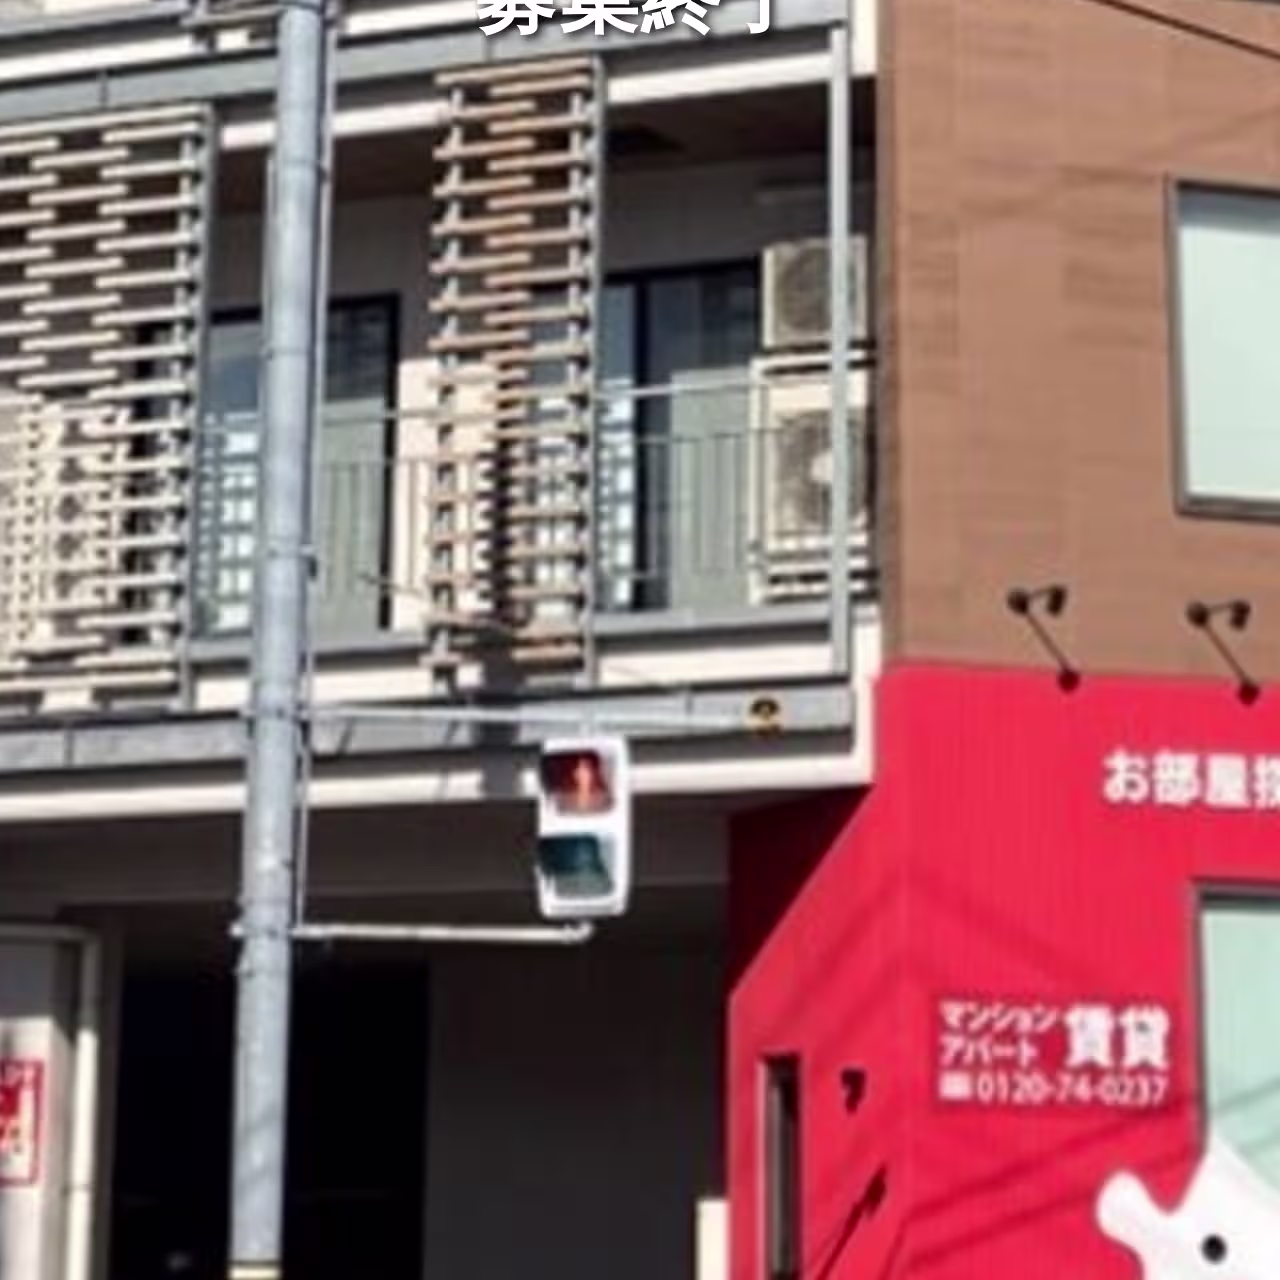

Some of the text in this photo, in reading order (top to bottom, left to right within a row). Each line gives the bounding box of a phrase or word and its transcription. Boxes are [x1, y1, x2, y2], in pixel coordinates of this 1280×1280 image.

[939, 1000, 1059, 1034] マンション
[939, 1035, 1038, 1067] アパート
